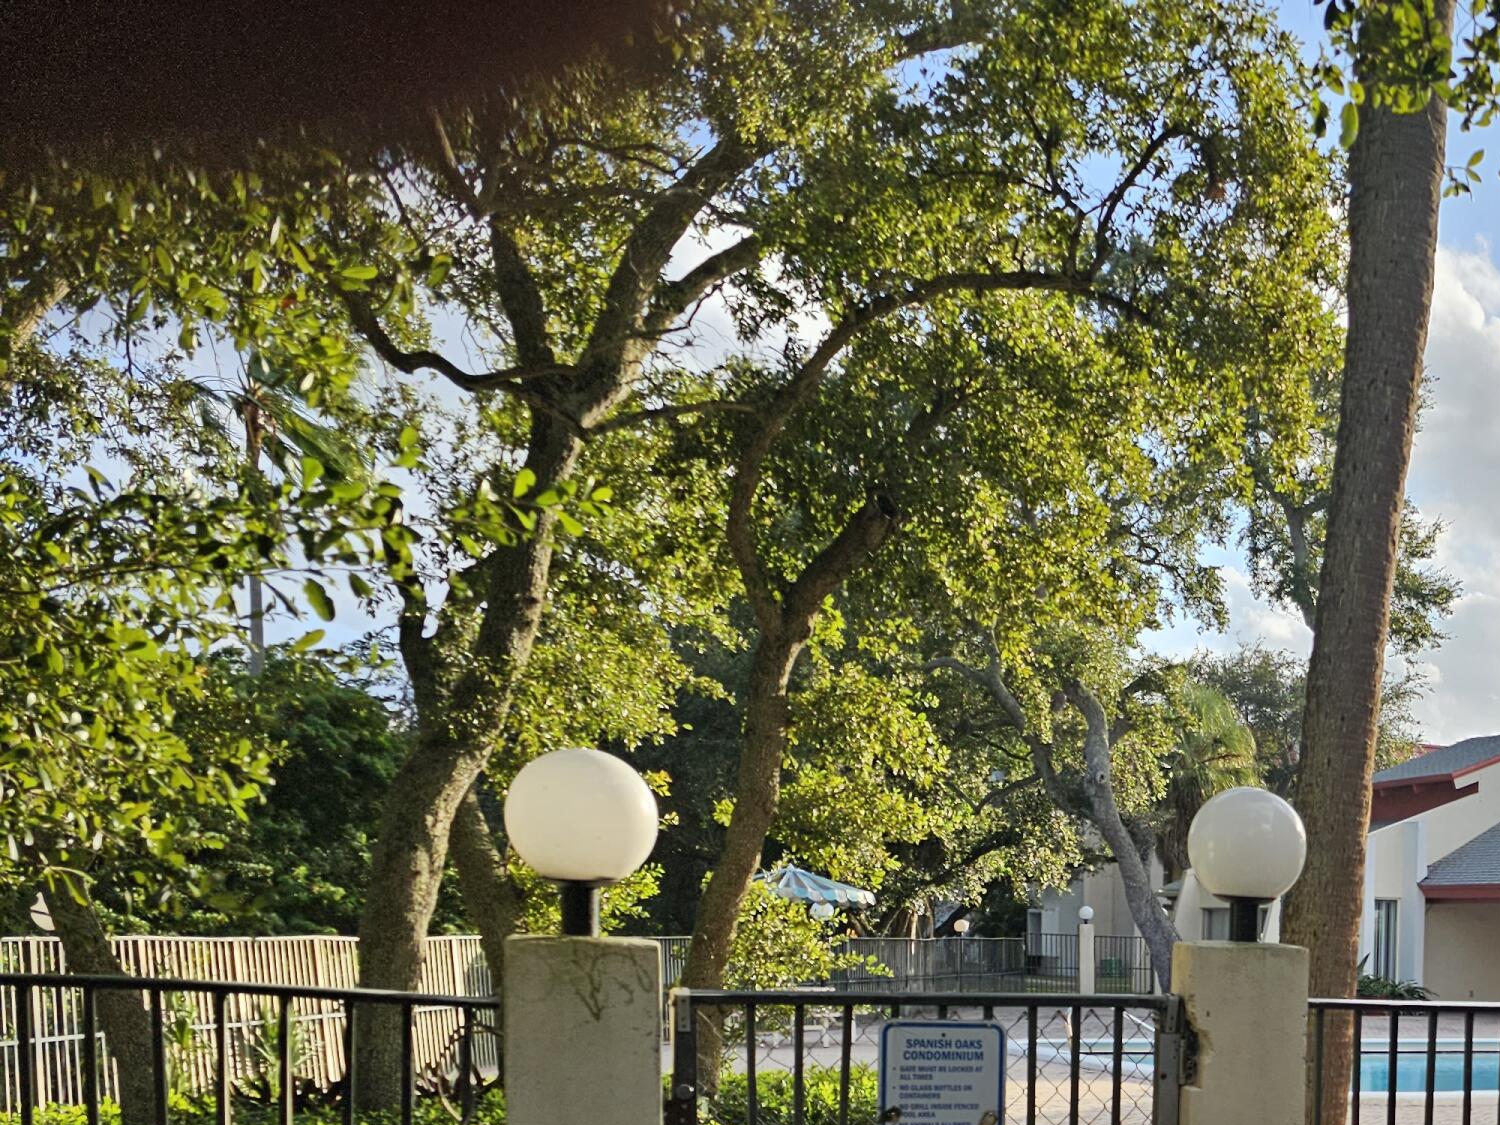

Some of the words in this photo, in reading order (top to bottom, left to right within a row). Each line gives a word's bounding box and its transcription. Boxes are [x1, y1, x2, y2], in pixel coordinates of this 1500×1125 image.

[906, 1039, 952, 1049] SPANISH
[955, 1040, 983, 1049] OAKS
[903, 1051, 984, 1061] CONDOMINIUM
[934, 1084, 962, 1092] BOTTLES
